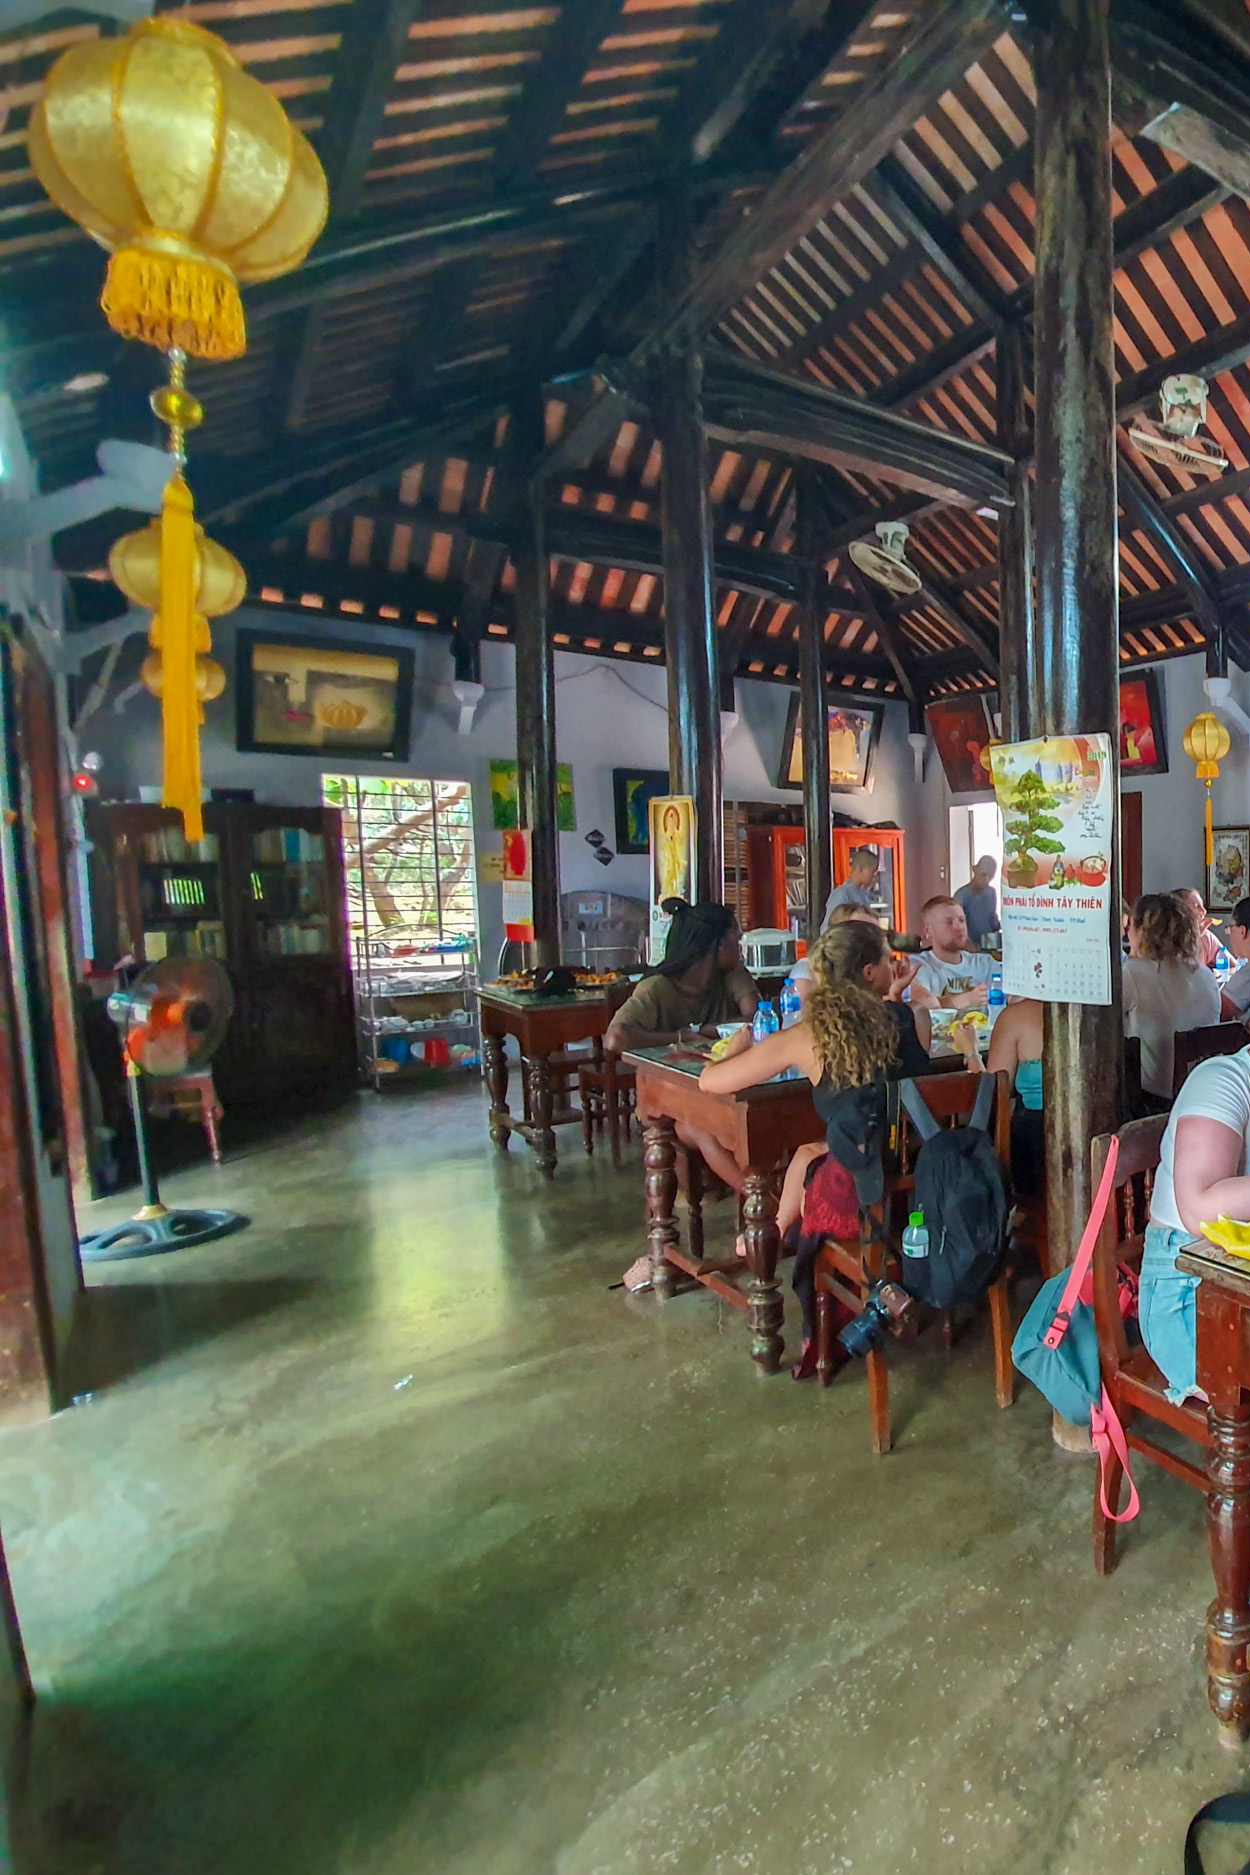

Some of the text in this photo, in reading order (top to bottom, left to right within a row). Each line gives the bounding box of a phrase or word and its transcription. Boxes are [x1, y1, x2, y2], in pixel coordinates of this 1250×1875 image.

[1056, 896, 1073, 908] TÂY
[1075, 896, 1103, 909] THIÊN
[947, 976, 973, 990] NIKE
